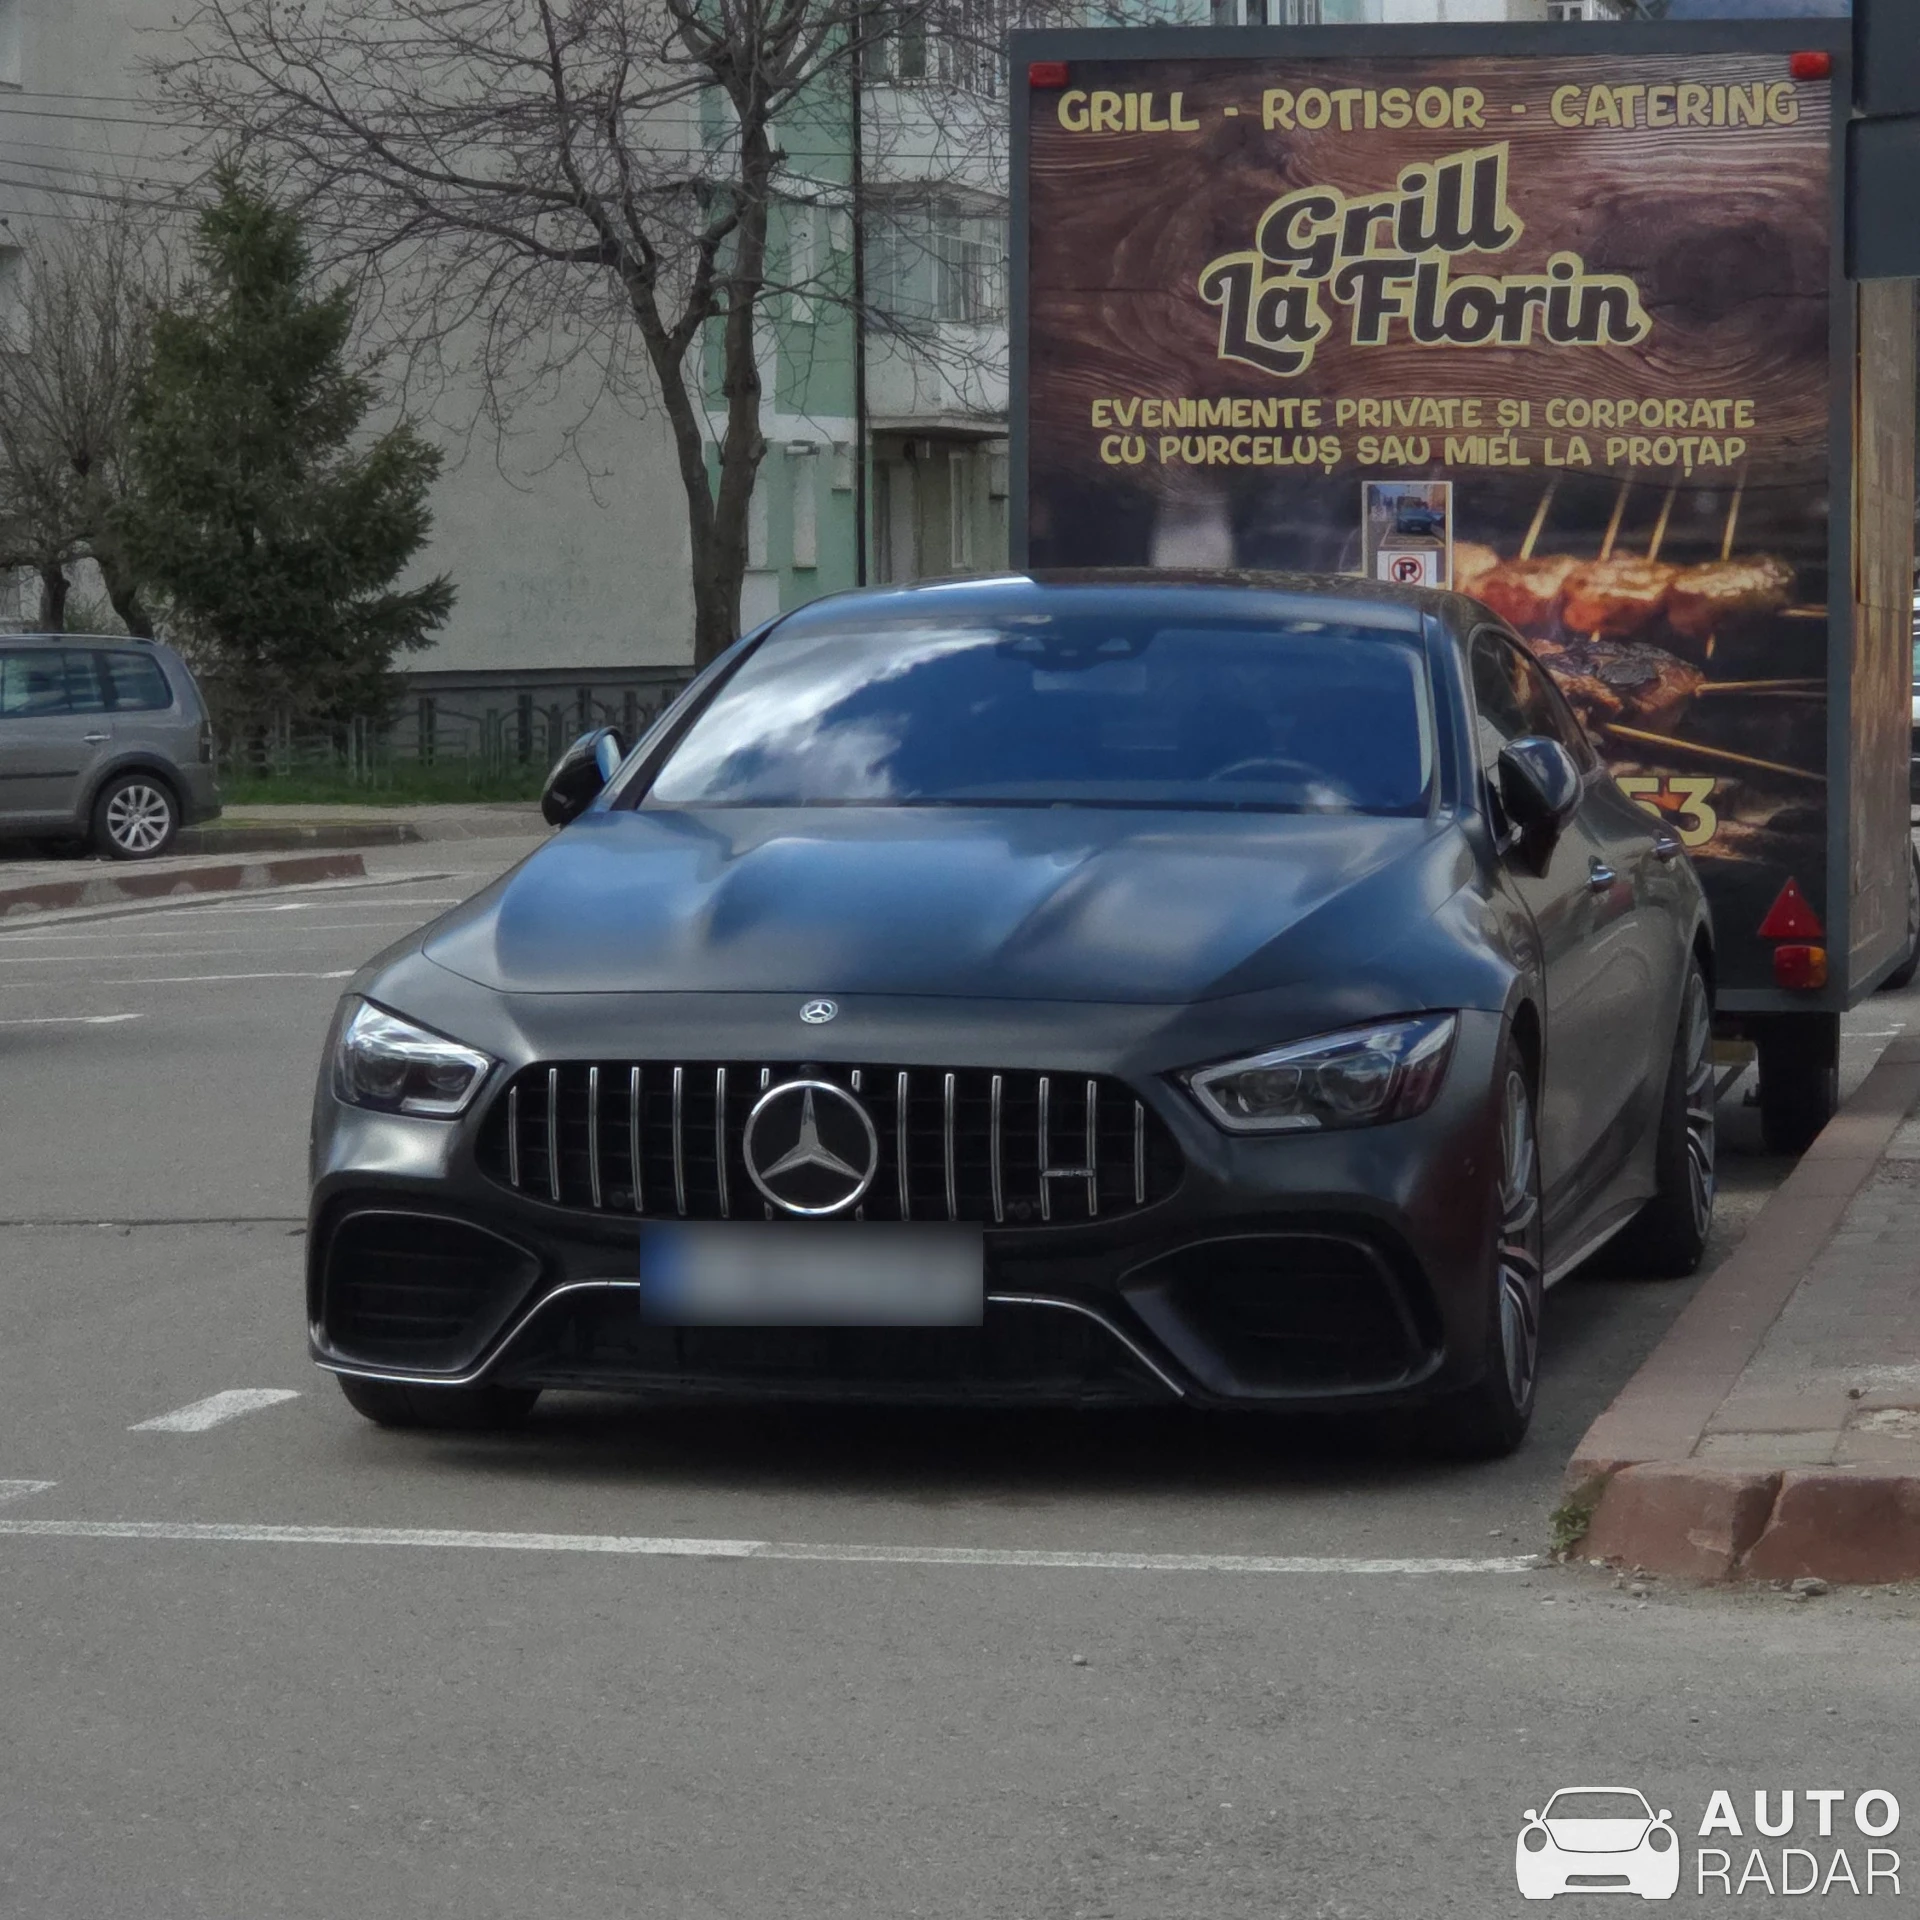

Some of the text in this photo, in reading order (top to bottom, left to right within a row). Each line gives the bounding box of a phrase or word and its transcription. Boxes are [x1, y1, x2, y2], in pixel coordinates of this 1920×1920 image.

[1058, 91, 1199, 132] GRILL
[1262, 87, 1486, 131] ROTISOR
[1550, 82, 1800, 128] CATERING
[1256, 142, 1524, 279] Grill
[1201, 255, 1648, 375] La Florin
[1092, 397, 1321, 428] EVENIMENTE
[1336, 398, 1482, 428] PRIVATE
[1546, 398, 1755, 429] CORPORATE
[1100, 435, 1746, 477] CU PURCELUȘ SAU MIEL LA PROȚAP
